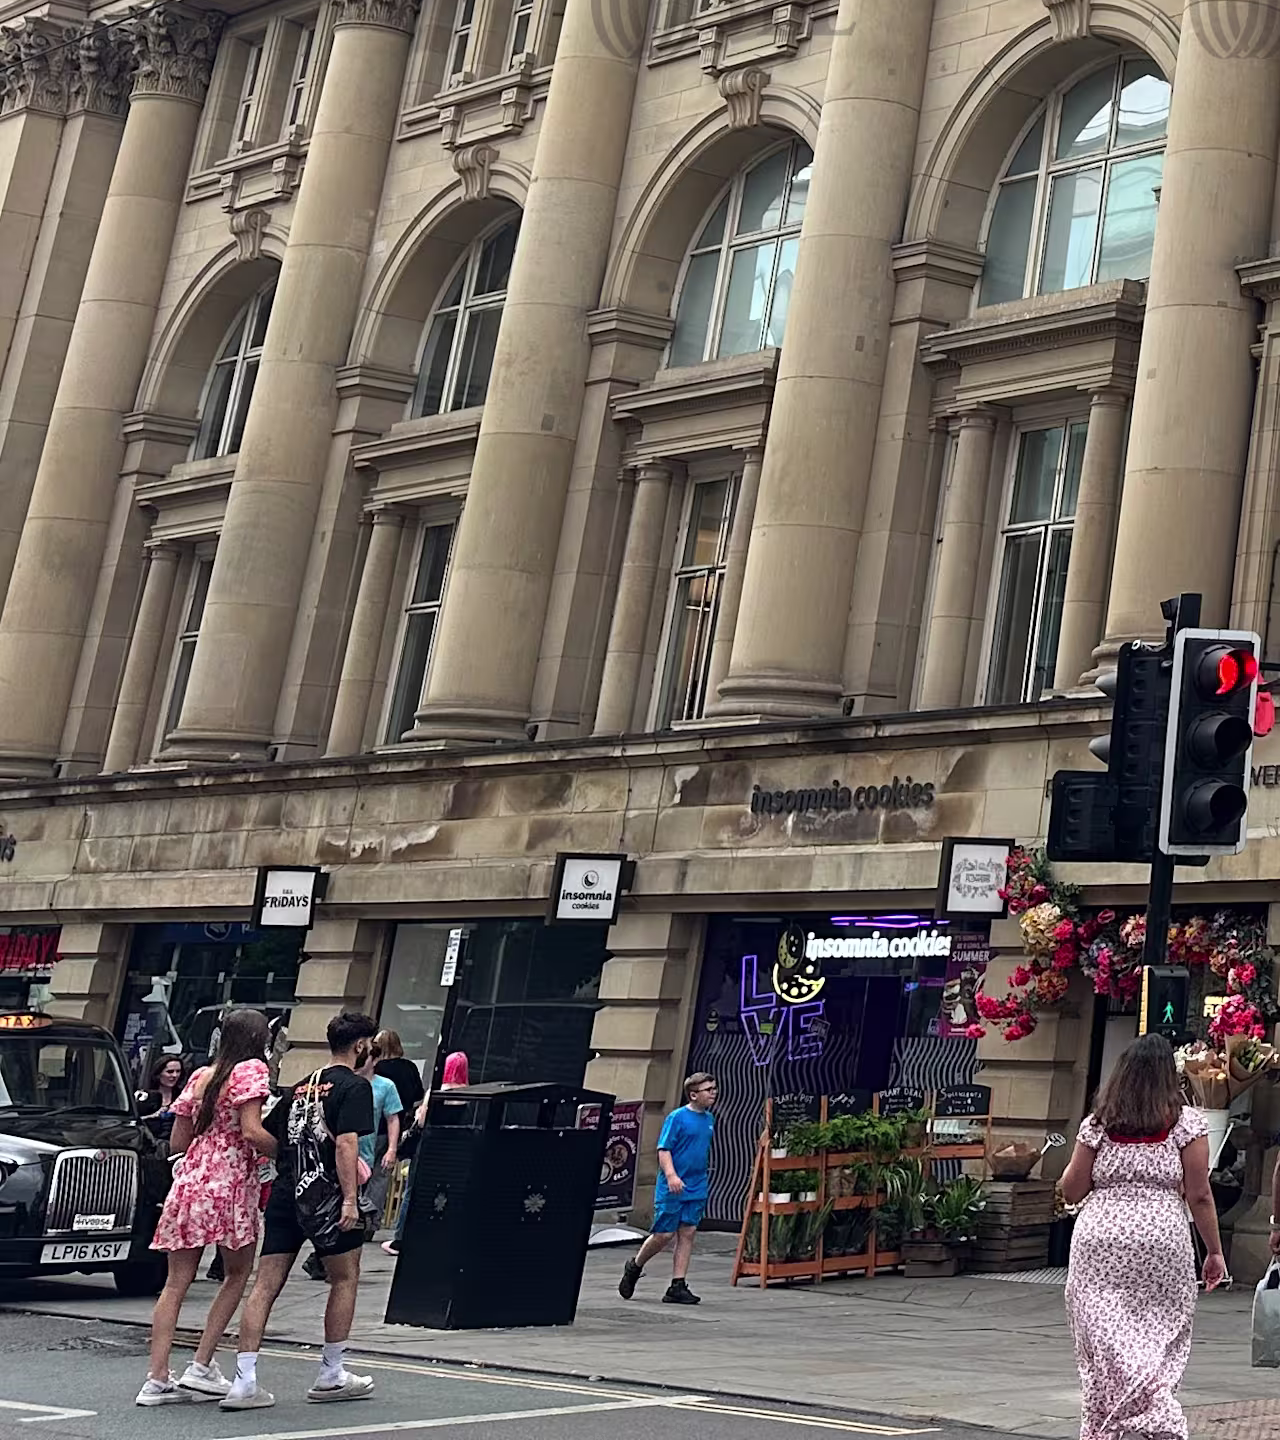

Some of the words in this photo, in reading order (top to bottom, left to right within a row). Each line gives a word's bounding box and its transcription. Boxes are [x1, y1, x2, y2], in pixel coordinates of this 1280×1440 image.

[750, 779, 851, 814] insomnia
[853, 776, 936, 808] cookies
[562, 890, 612, 901] insomnia
[572, 902, 600, 910] cookies
[805, 931, 888, 961] insomnia
[952, 950, 990, 962] SUMMER
[3, 1016, 43, 1027] TAXI
[52, 1246, 88, 1260] LP16
[91, 1244, 122, 1259] KSV
